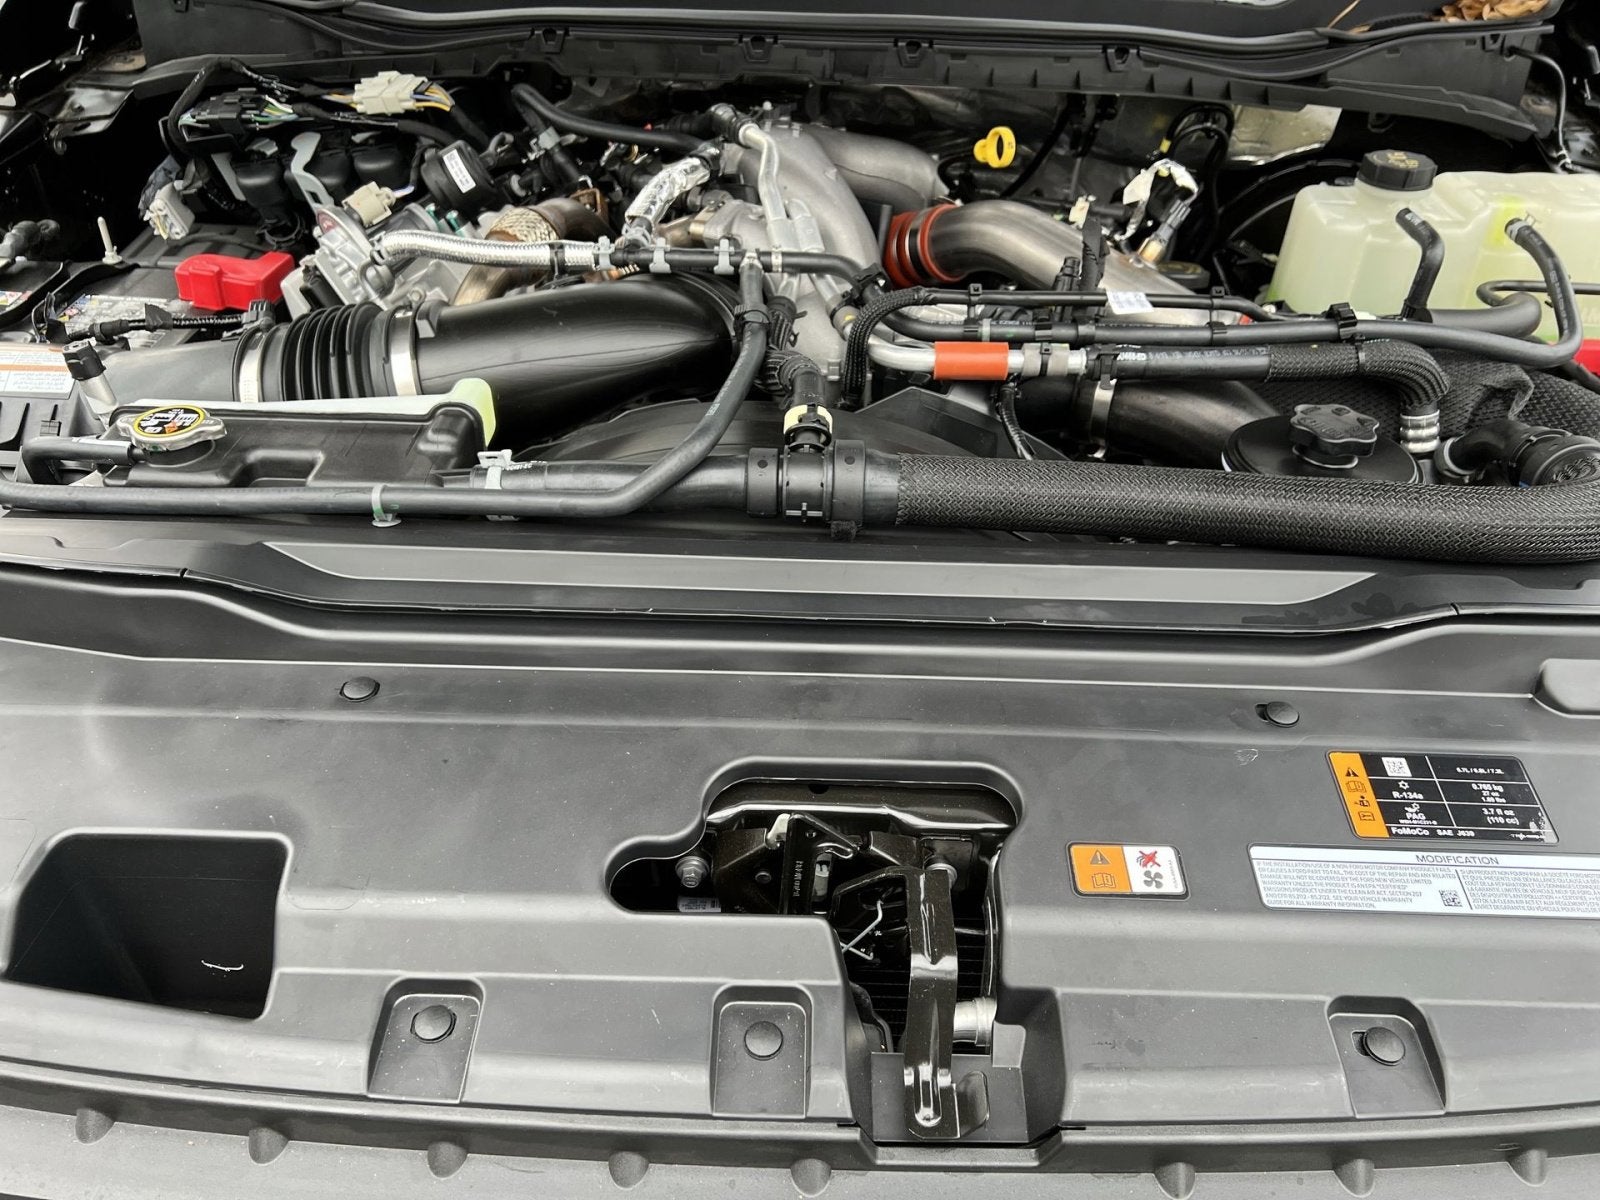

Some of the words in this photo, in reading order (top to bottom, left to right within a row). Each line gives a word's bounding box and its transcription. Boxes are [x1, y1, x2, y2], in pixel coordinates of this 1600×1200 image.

[1492, 784, 1504, 792] kg
[1392, 791, 1424, 799] R-134a
[1391, 827, 1429, 835] FoMoCo
[1416, 854, 1499, 865] MODIFICATION
